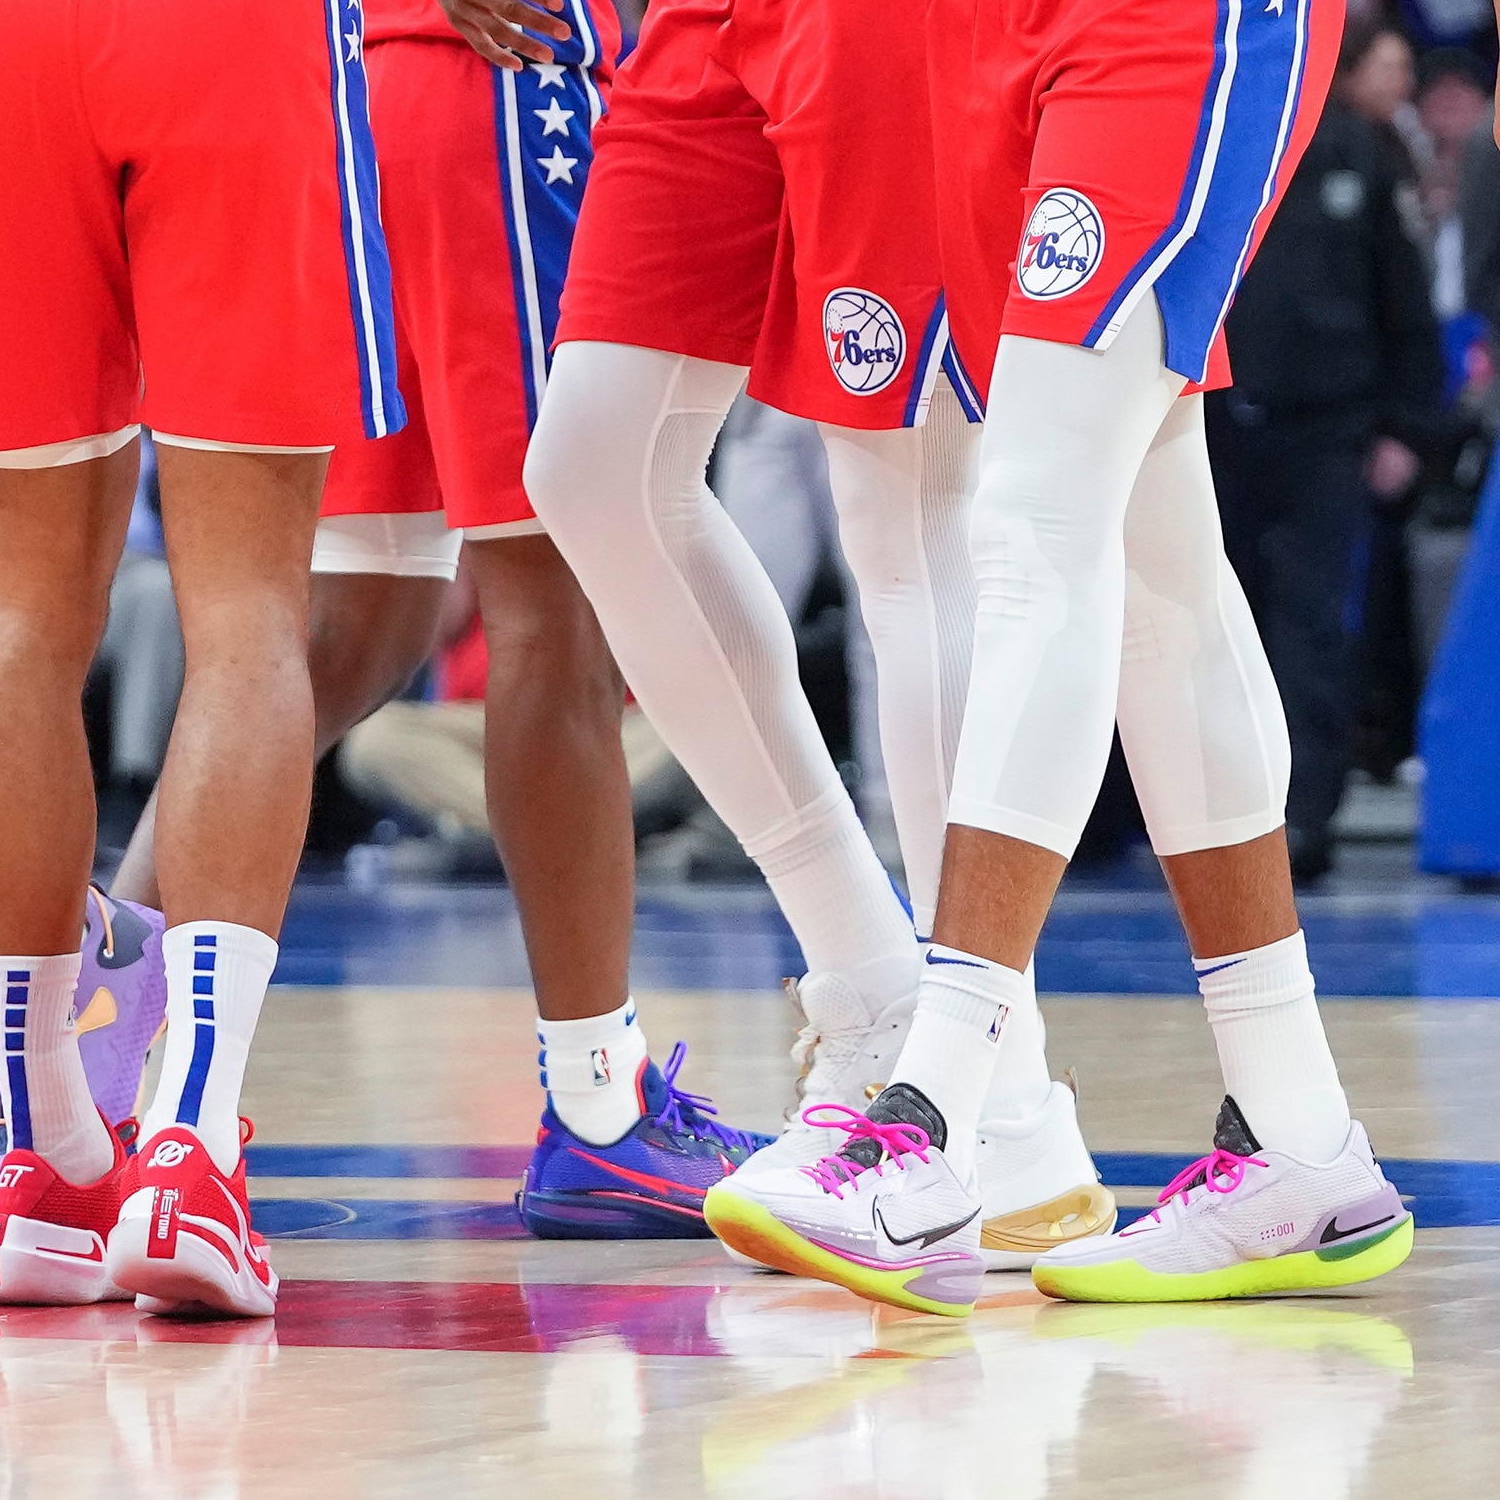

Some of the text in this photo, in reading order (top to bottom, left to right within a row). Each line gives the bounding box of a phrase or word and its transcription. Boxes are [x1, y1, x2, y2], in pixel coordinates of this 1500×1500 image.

[1022, 231, 1089, 272] 76ers
[829, 328, 897, 366] 76ers
[1276, 1222, 1295, 1237] 001
